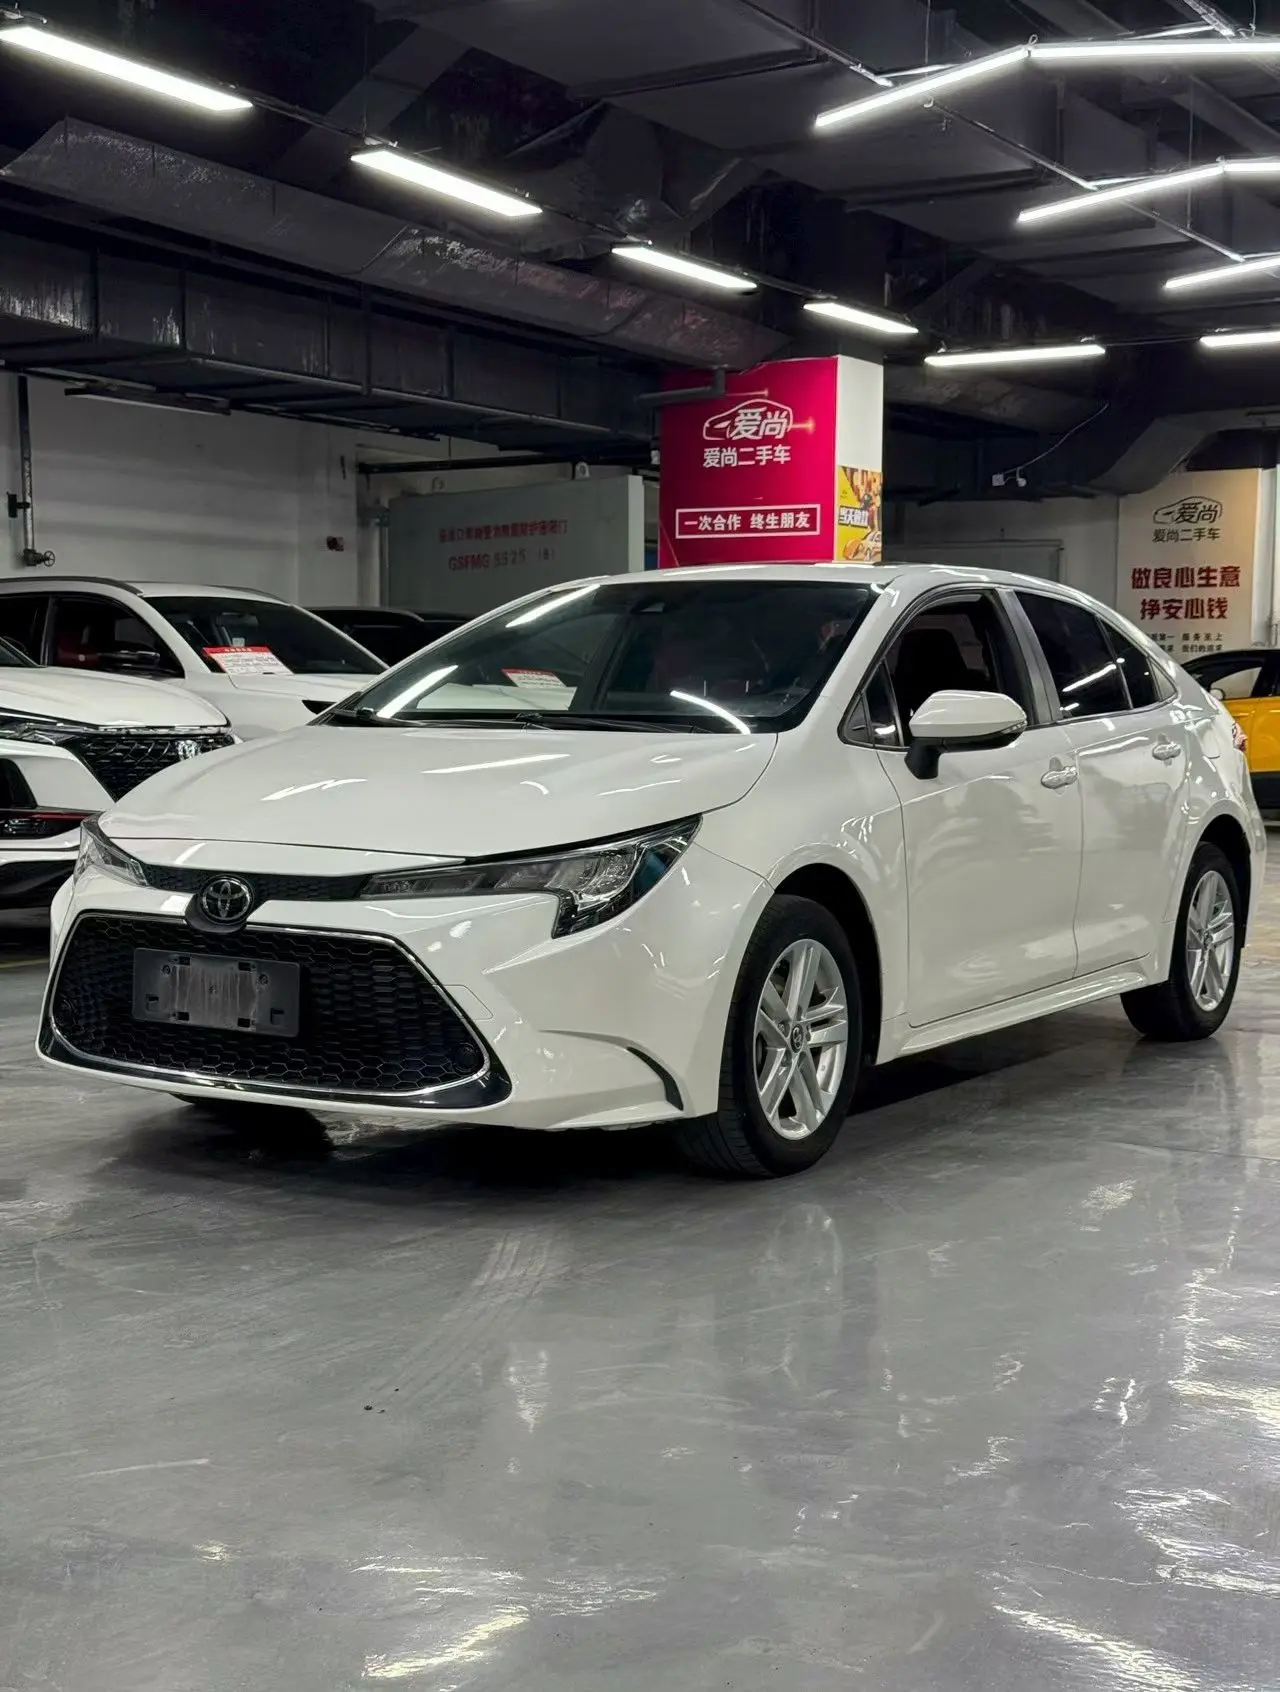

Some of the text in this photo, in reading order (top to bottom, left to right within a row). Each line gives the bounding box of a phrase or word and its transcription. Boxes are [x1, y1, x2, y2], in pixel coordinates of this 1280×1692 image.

[730, 407, 788, 440] 爱尚
[703, 444, 791, 468] 爱尚二手车
[684, 511, 811, 531] 一次合作 终生朋友
[1174, 501, 1219, 524] 爱尚
[1152, 527, 1221, 543] 爱尚二手车
[1131, 565, 1241, 589] 做良心生意
[1140, 597, 1229, 621] 挣安心钱
